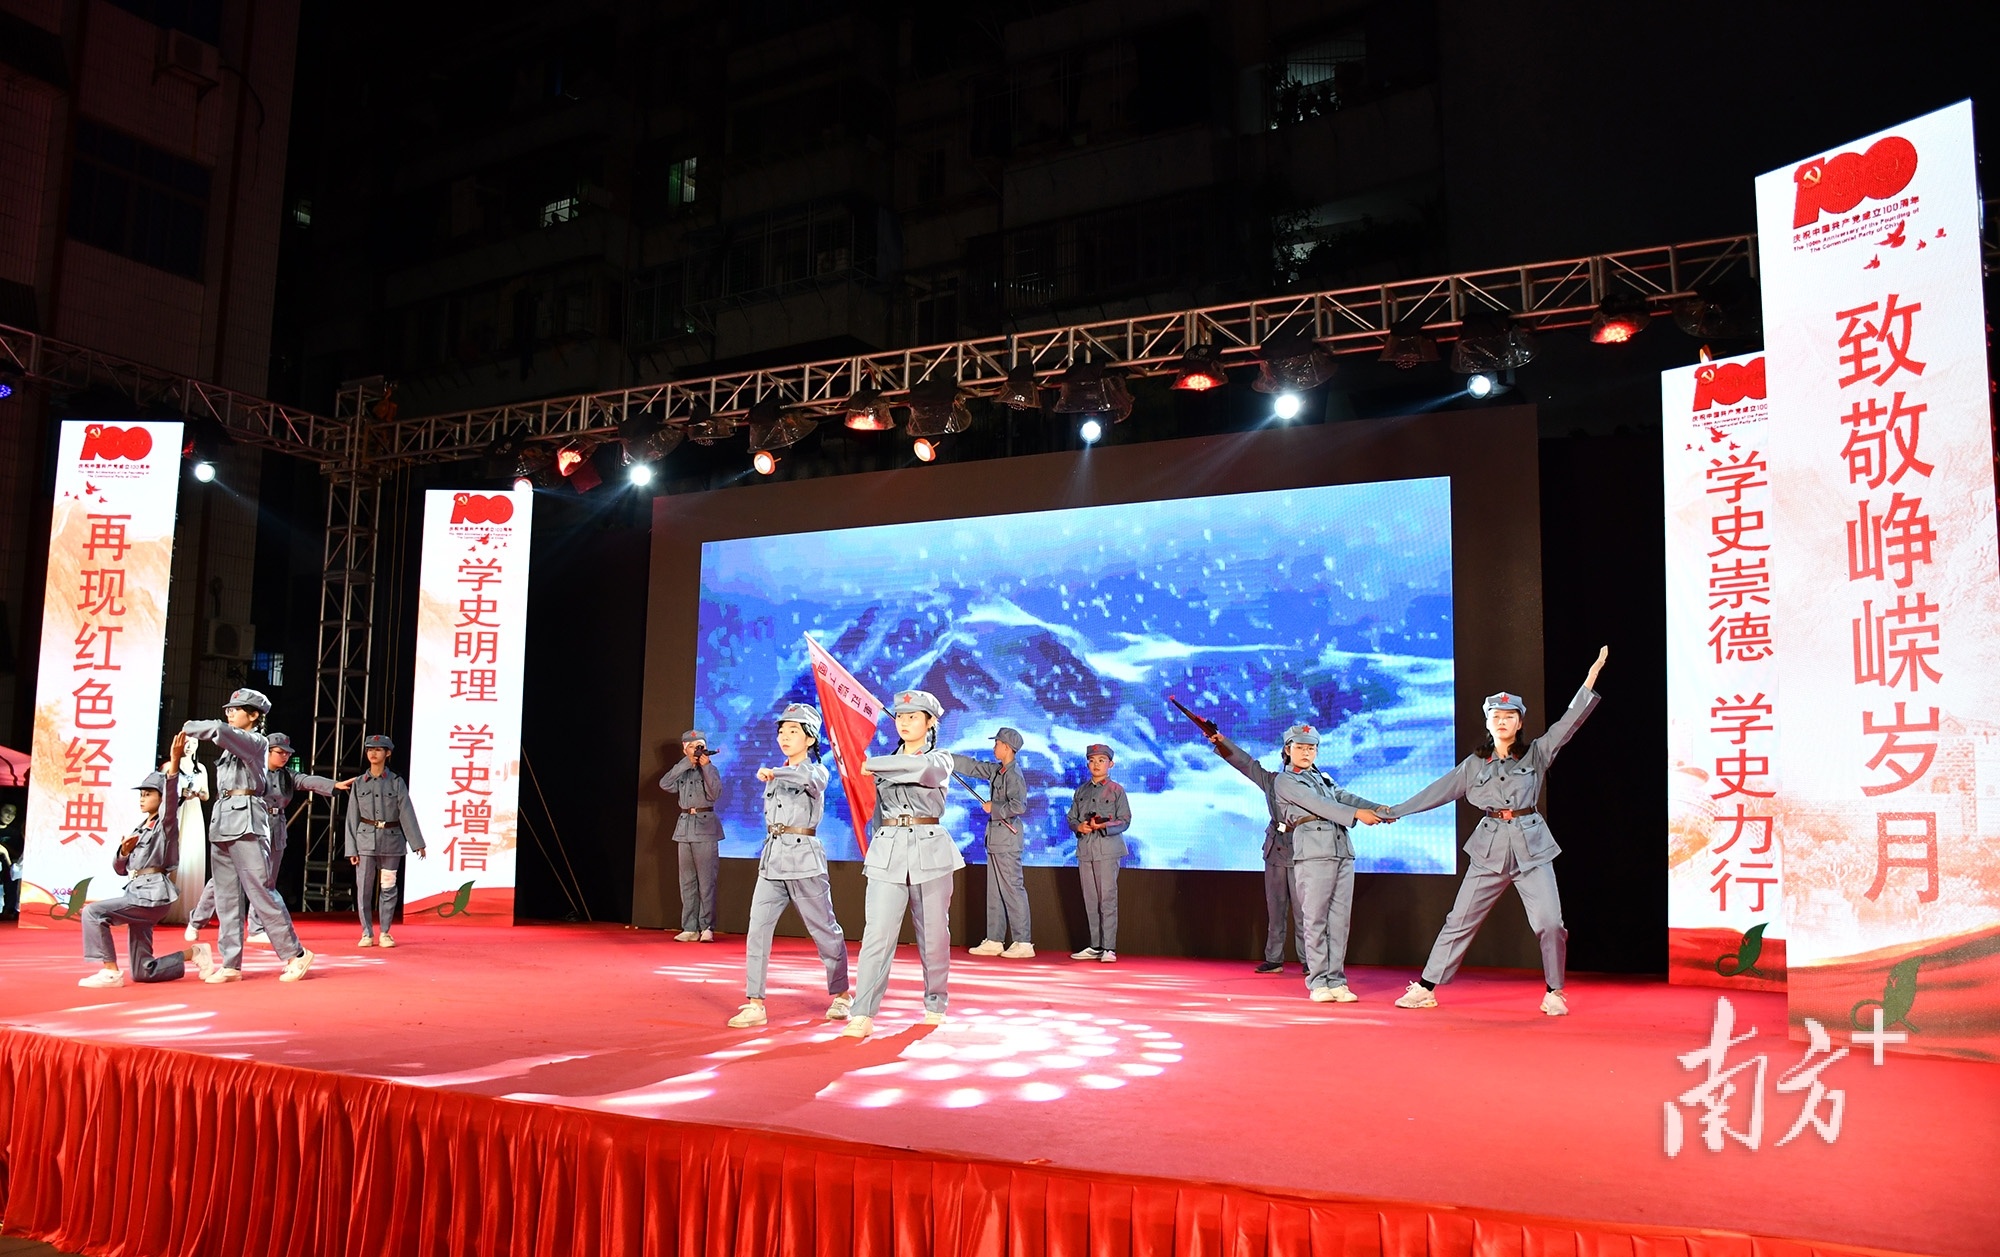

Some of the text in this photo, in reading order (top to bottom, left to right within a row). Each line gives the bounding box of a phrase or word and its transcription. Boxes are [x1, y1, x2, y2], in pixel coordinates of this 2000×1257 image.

[59, 514, 132, 846] 再现红色经典
[449, 557, 502, 703] 学史明理
[1706, 450, 1778, 913] 学史崇德 学史力行
[1835, 293, 1942, 905] 致敬峥嵘岁月
[443, 724, 494, 872] 学史增信
